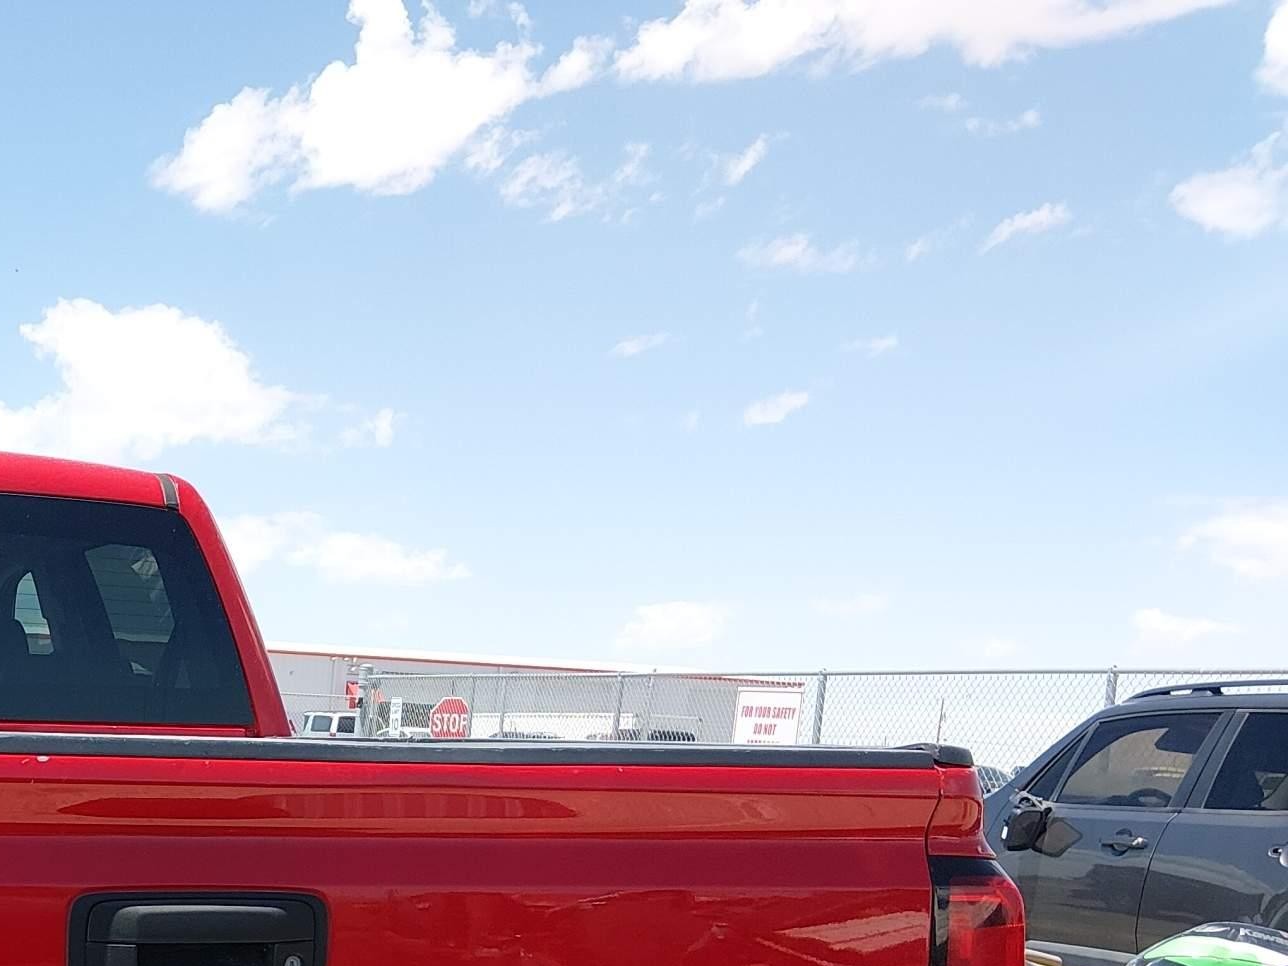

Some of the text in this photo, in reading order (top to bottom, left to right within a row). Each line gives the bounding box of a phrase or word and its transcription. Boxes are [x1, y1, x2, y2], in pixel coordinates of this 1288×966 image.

[741, 705, 796, 720] FOR YOUR SAFETY
[432, 713, 468, 732] STOP
[753, 723, 777, 736] DO NOT
